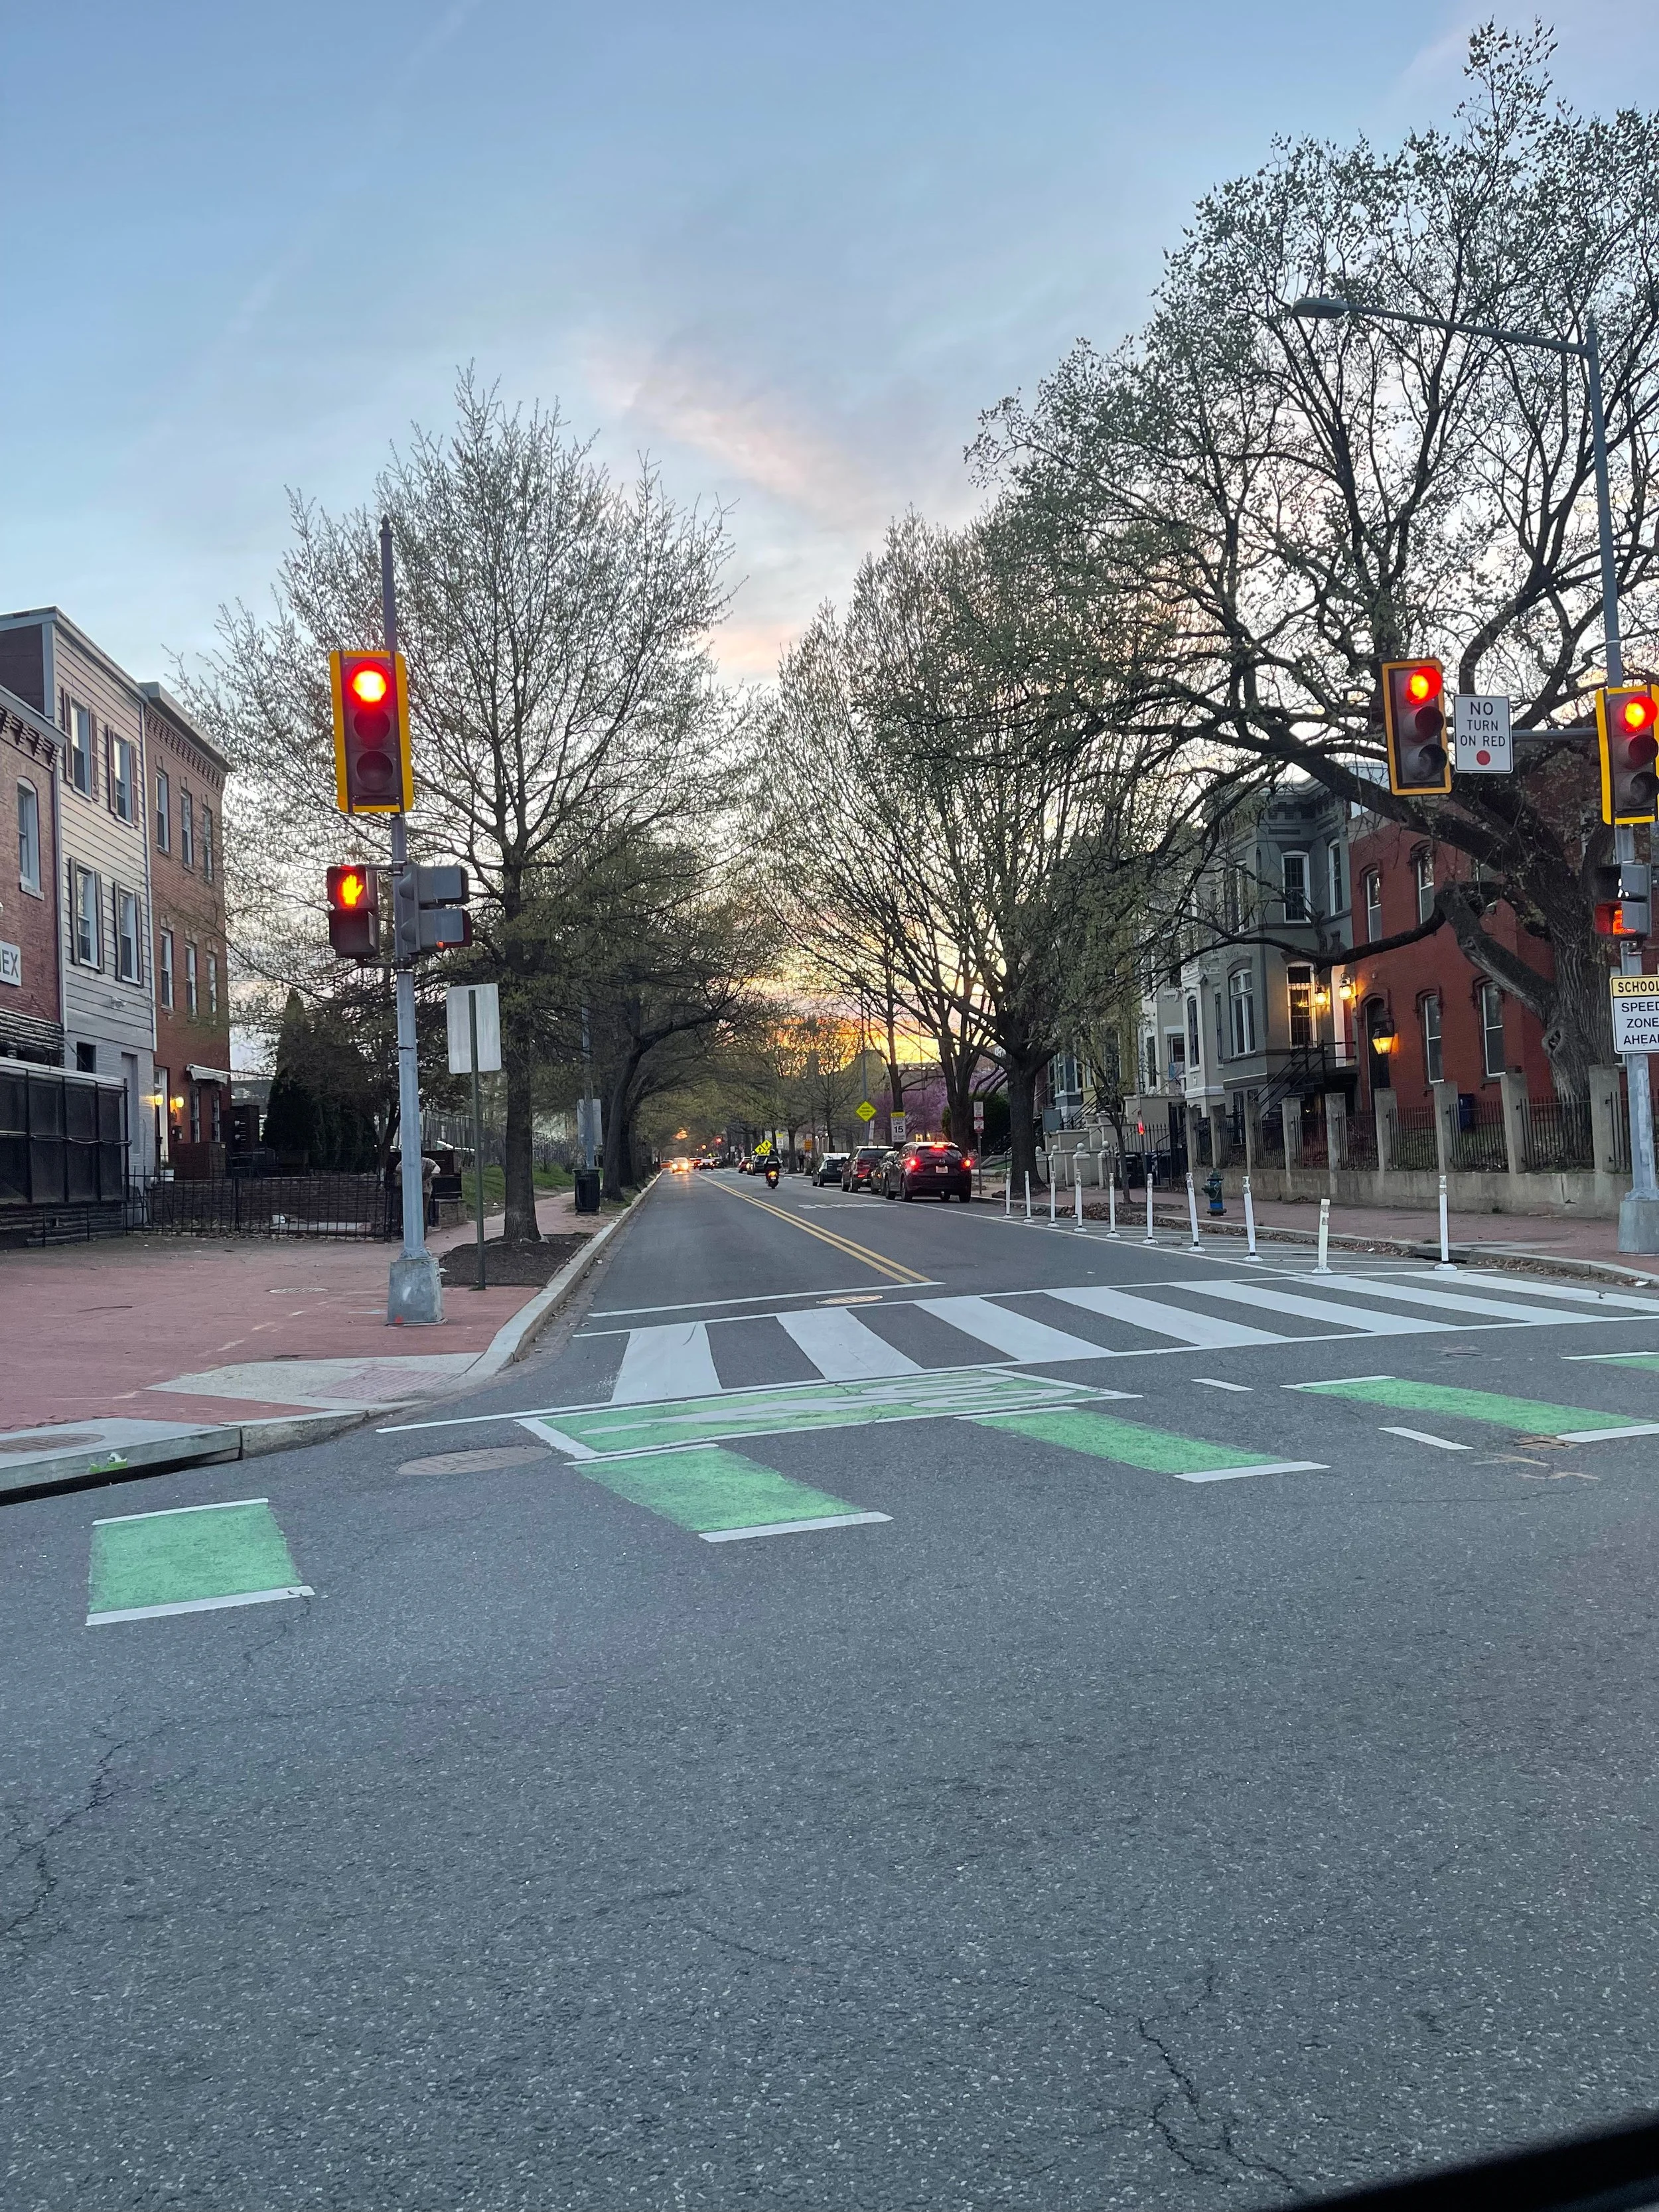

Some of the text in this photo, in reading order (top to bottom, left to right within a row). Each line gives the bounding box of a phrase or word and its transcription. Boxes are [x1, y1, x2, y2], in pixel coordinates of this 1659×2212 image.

[1471, 701, 1493, 715] NO
[1467, 719, 1498, 731] TURN
[1461, 735, 1505, 747] ON RED
[1626, 1017, 1659, 1028] ZONE
[1623, 1033, 1659, 1045] AHEA
